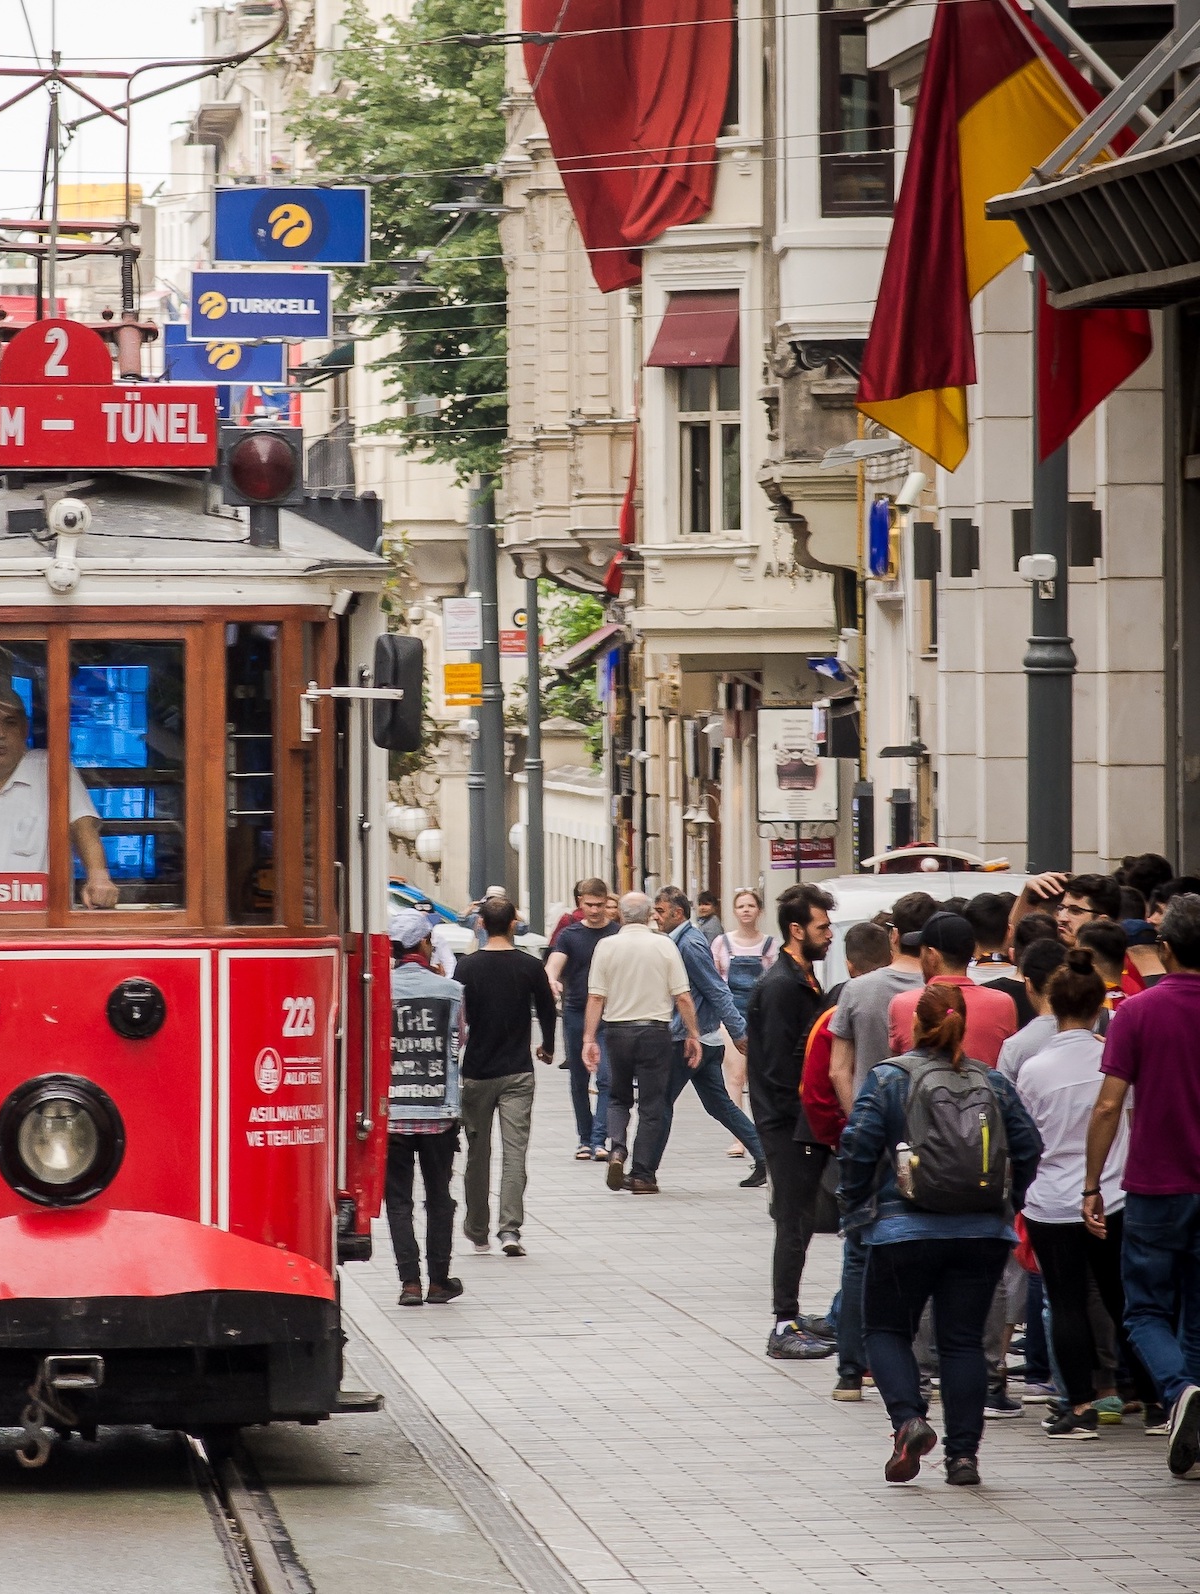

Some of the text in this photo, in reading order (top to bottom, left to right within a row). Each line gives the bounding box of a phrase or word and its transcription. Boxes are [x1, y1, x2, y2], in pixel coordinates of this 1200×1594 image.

[227, 298, 320, 314] TURKCELL
[44, 327, 69, 377] 2
[101, 392, 207, 444] TÜNEL
[282, 996, 316, 1037] 223
[396, 1005, 436, 1032] THE
